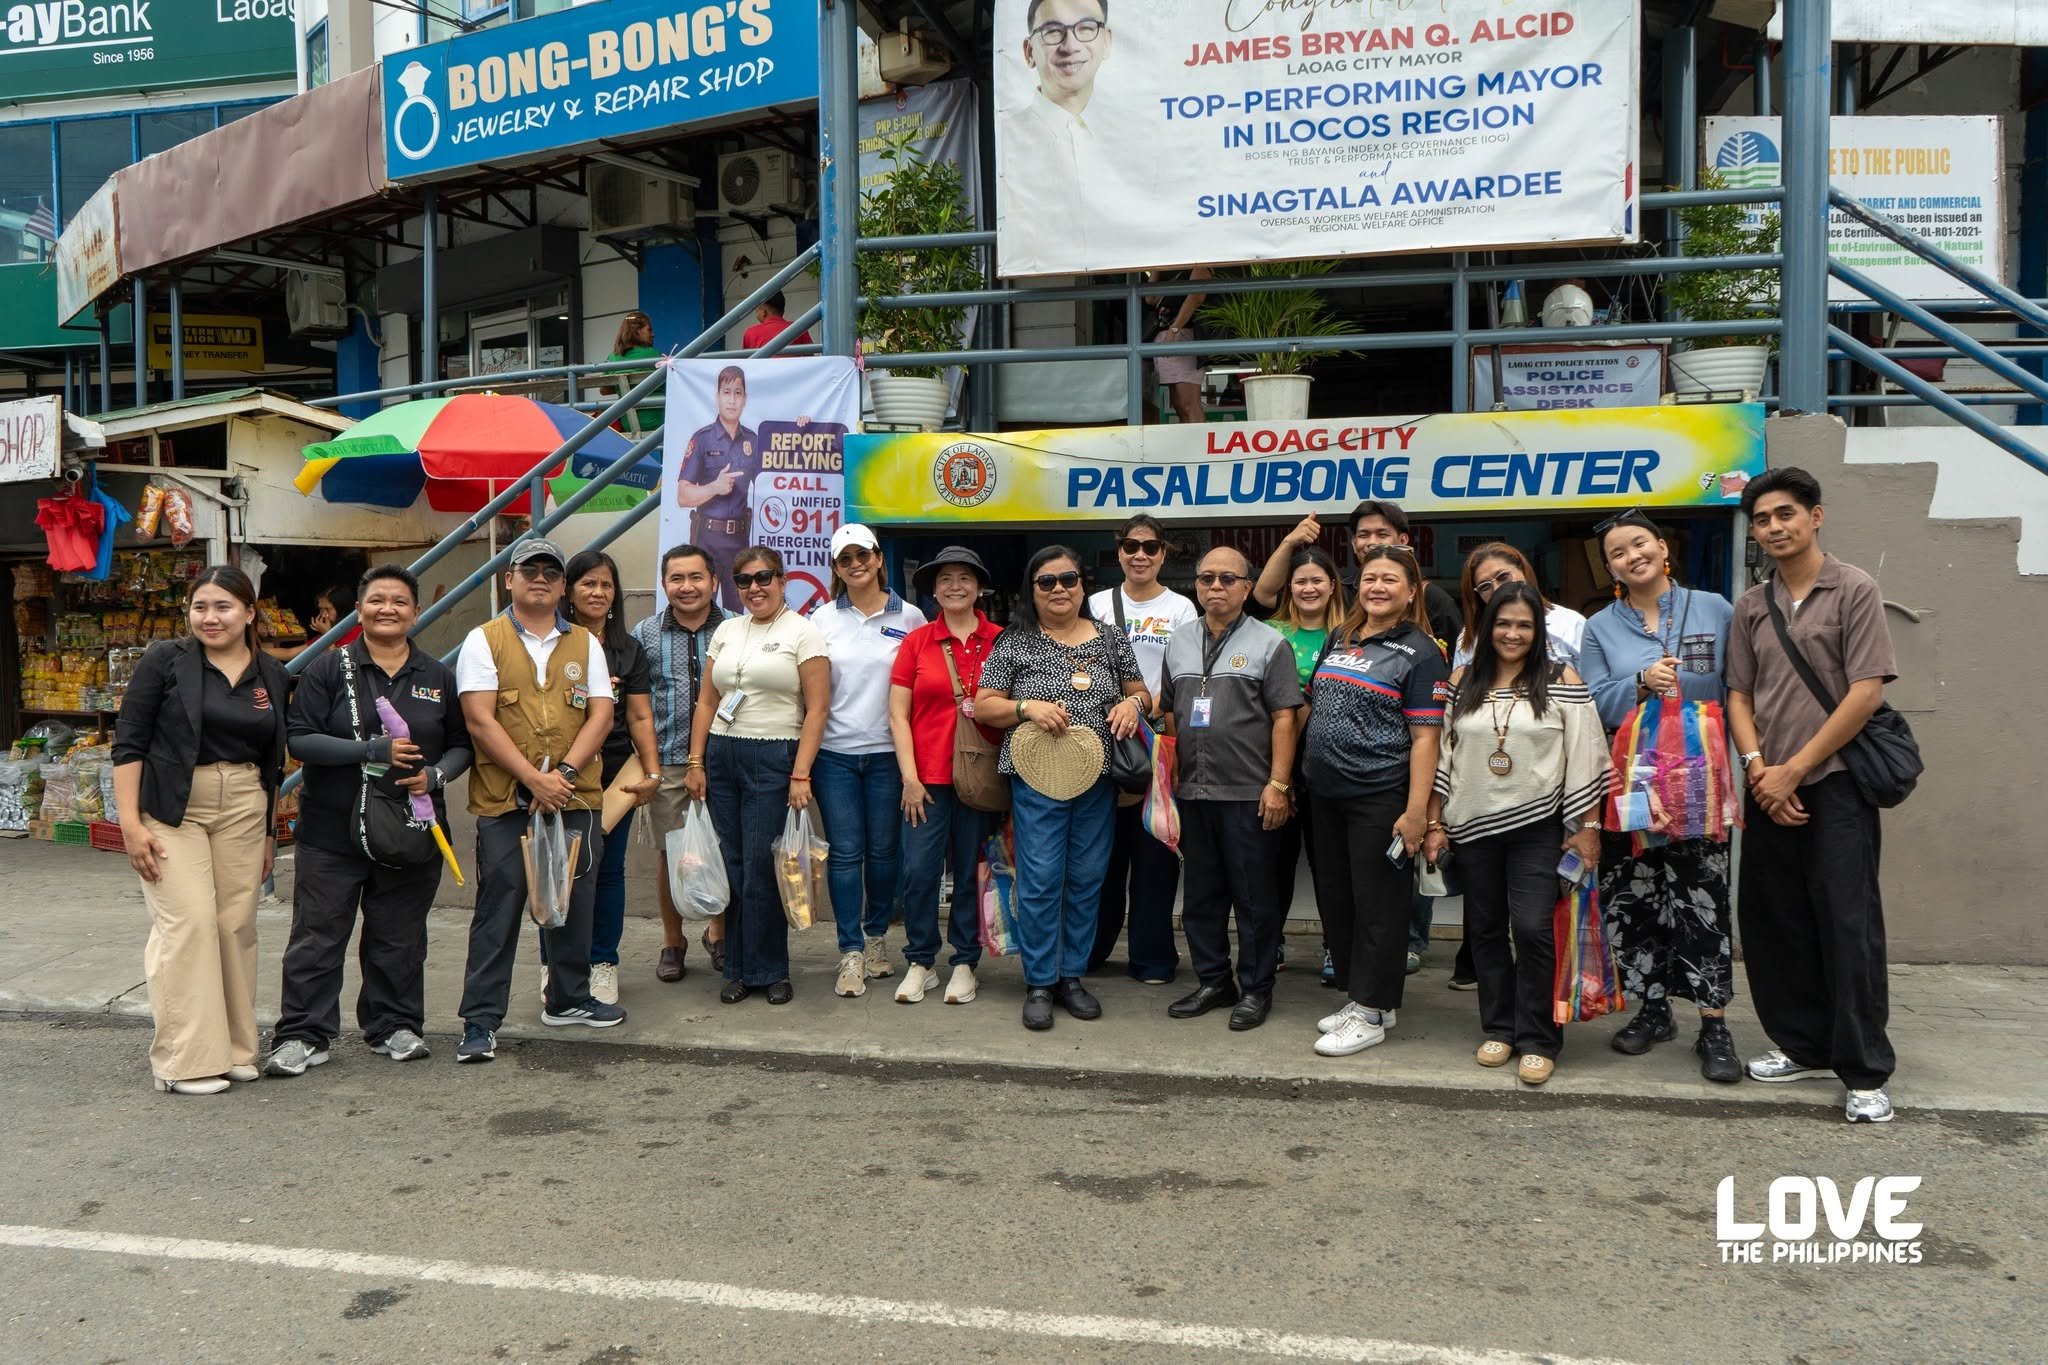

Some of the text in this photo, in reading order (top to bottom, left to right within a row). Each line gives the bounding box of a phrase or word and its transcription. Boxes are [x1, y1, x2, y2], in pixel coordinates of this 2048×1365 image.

[1184, 36, 1291, 67] JAMES
[1302, 26, 1413, 57] BRYAN
[1425, 23, 1459, 47] Q.
[1470, 11, 1574, 44] ALCID
[93, 48, 154, 65] Since 1956
[448, 0, 774, 110] BONG-BONG'S
[1287, 51, 1462, 75] LAOAG CITY MAYOR
[451, 57, 774, 145] JEWELRY & REPAIR SHOP
[1160, 63, 1602, 120] TOP-PERFORMING MAYOR
[1224, 103, 1534, 148] IN ILOCOS REGION
[1245, 133, 1510, 160] BOSES NG BAYANG INDEX OF GOVERNANCE (IOG)
[1288, 147, 1465, 166] TRUST & PERFORMANCE RATINGS
[1840, 148, 1860, 175] TO
[1864, 148, 1891, 175] THE
[1895, 147, 1950, 175] PUBLIC
[1359, 161, 1391, 184] and
[1198, 171, 1562, 217] SINAGTALA AWARDEE
[1859, 197, 1896, 209] MARKET
[1898, 197, 1916, 209] AND
[1919, 196, 1981, 209] COMMERCIAL
[1261, 205, 1495, 227] OVERSEAS WORKERS WELFARE ADMINISTRATION
[1309, 217, 1444, 233] REGIONAL WELFARE OFFICE
[1907, 212, 1932, 223] been
[1934, 212, 1967, 223] issued
[1970, 213, 1982, 222] an
[1944, 241, 1983, 251] Natural
[157, 327, 214, 335] WTERN
[166, 350, 249, 359] MNEY TRANSFER
[1508, 358, 1619, 369] LAOAG CITY POLICE STATION
[1526, 370, 1604, 382] POLICE
[1503, 383, 1633, 395] ASSISTANCE
[1537, 399, 1594, 409] DESK
[771, 433, 835, 451] REPORT
[1207, 427, 1417, 454] LAOAG CITY
[761, 452, 842, 471] BULLYING
[773, 476, 828, 492] CALL
[1068, 449, 1660, 508] PASALUBONG CENTER
[792, 496, 841, 508] UNIFIED
[792, 510, 840, 534] 911
[759, 536, 831, 548] EMERGENC
[412, 684, 441, 699] LOVE
[350, 698, 360, 726] Reebok
